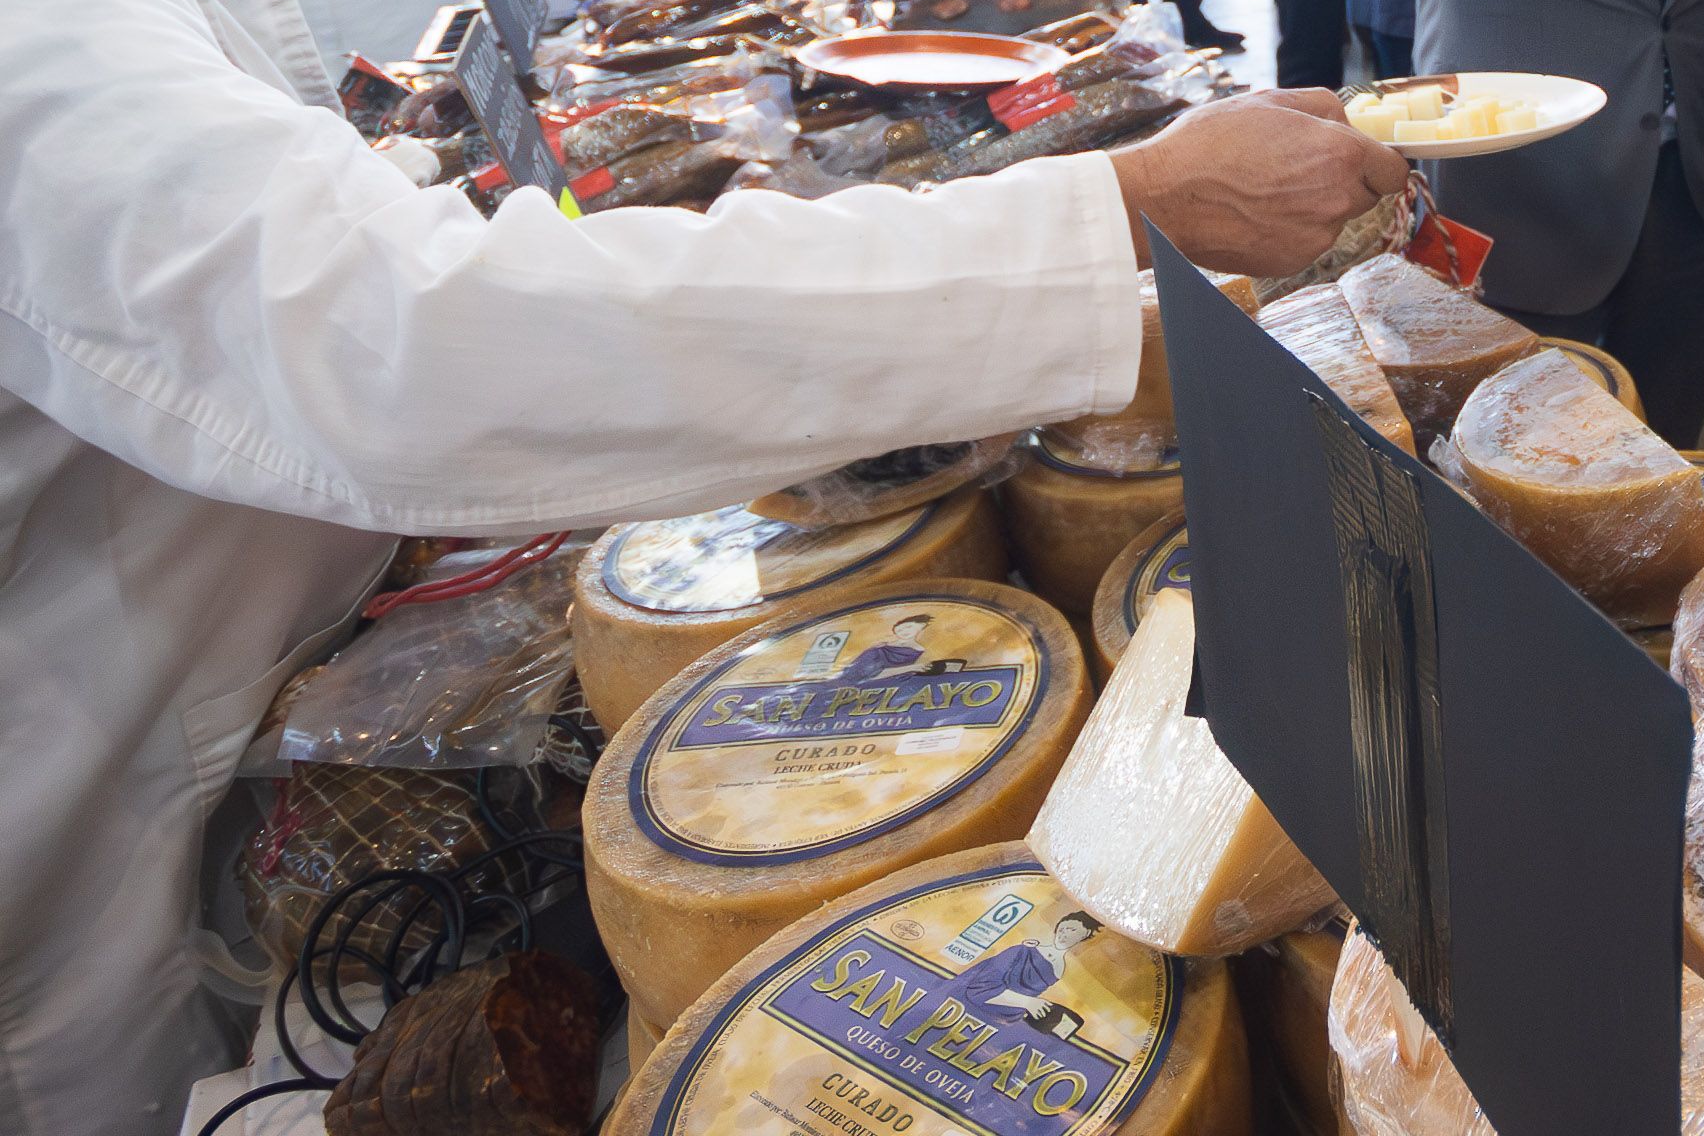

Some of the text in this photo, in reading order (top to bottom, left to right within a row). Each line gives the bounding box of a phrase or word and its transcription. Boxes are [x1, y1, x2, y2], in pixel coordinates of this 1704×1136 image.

[703, 680, 1003, 727] SAN PELAYO
[831, 718, 857, 730] DE
[861, 715, 914, 730] OVEJA
[775, 743, 877, 762] CURADO
[774, 763, 813, 775] LECHE
[944, 943, 976, 962] AENOR
[810, 948, 927, 1030] SAN
[905, 998, 1089, 1118] PELAYO
[847, 1023, 976, 1106] QUESO DE OVEJA
[805, 1096, 843, 1127] LECHE
[822, 1072, 915, 1133] CURADO
